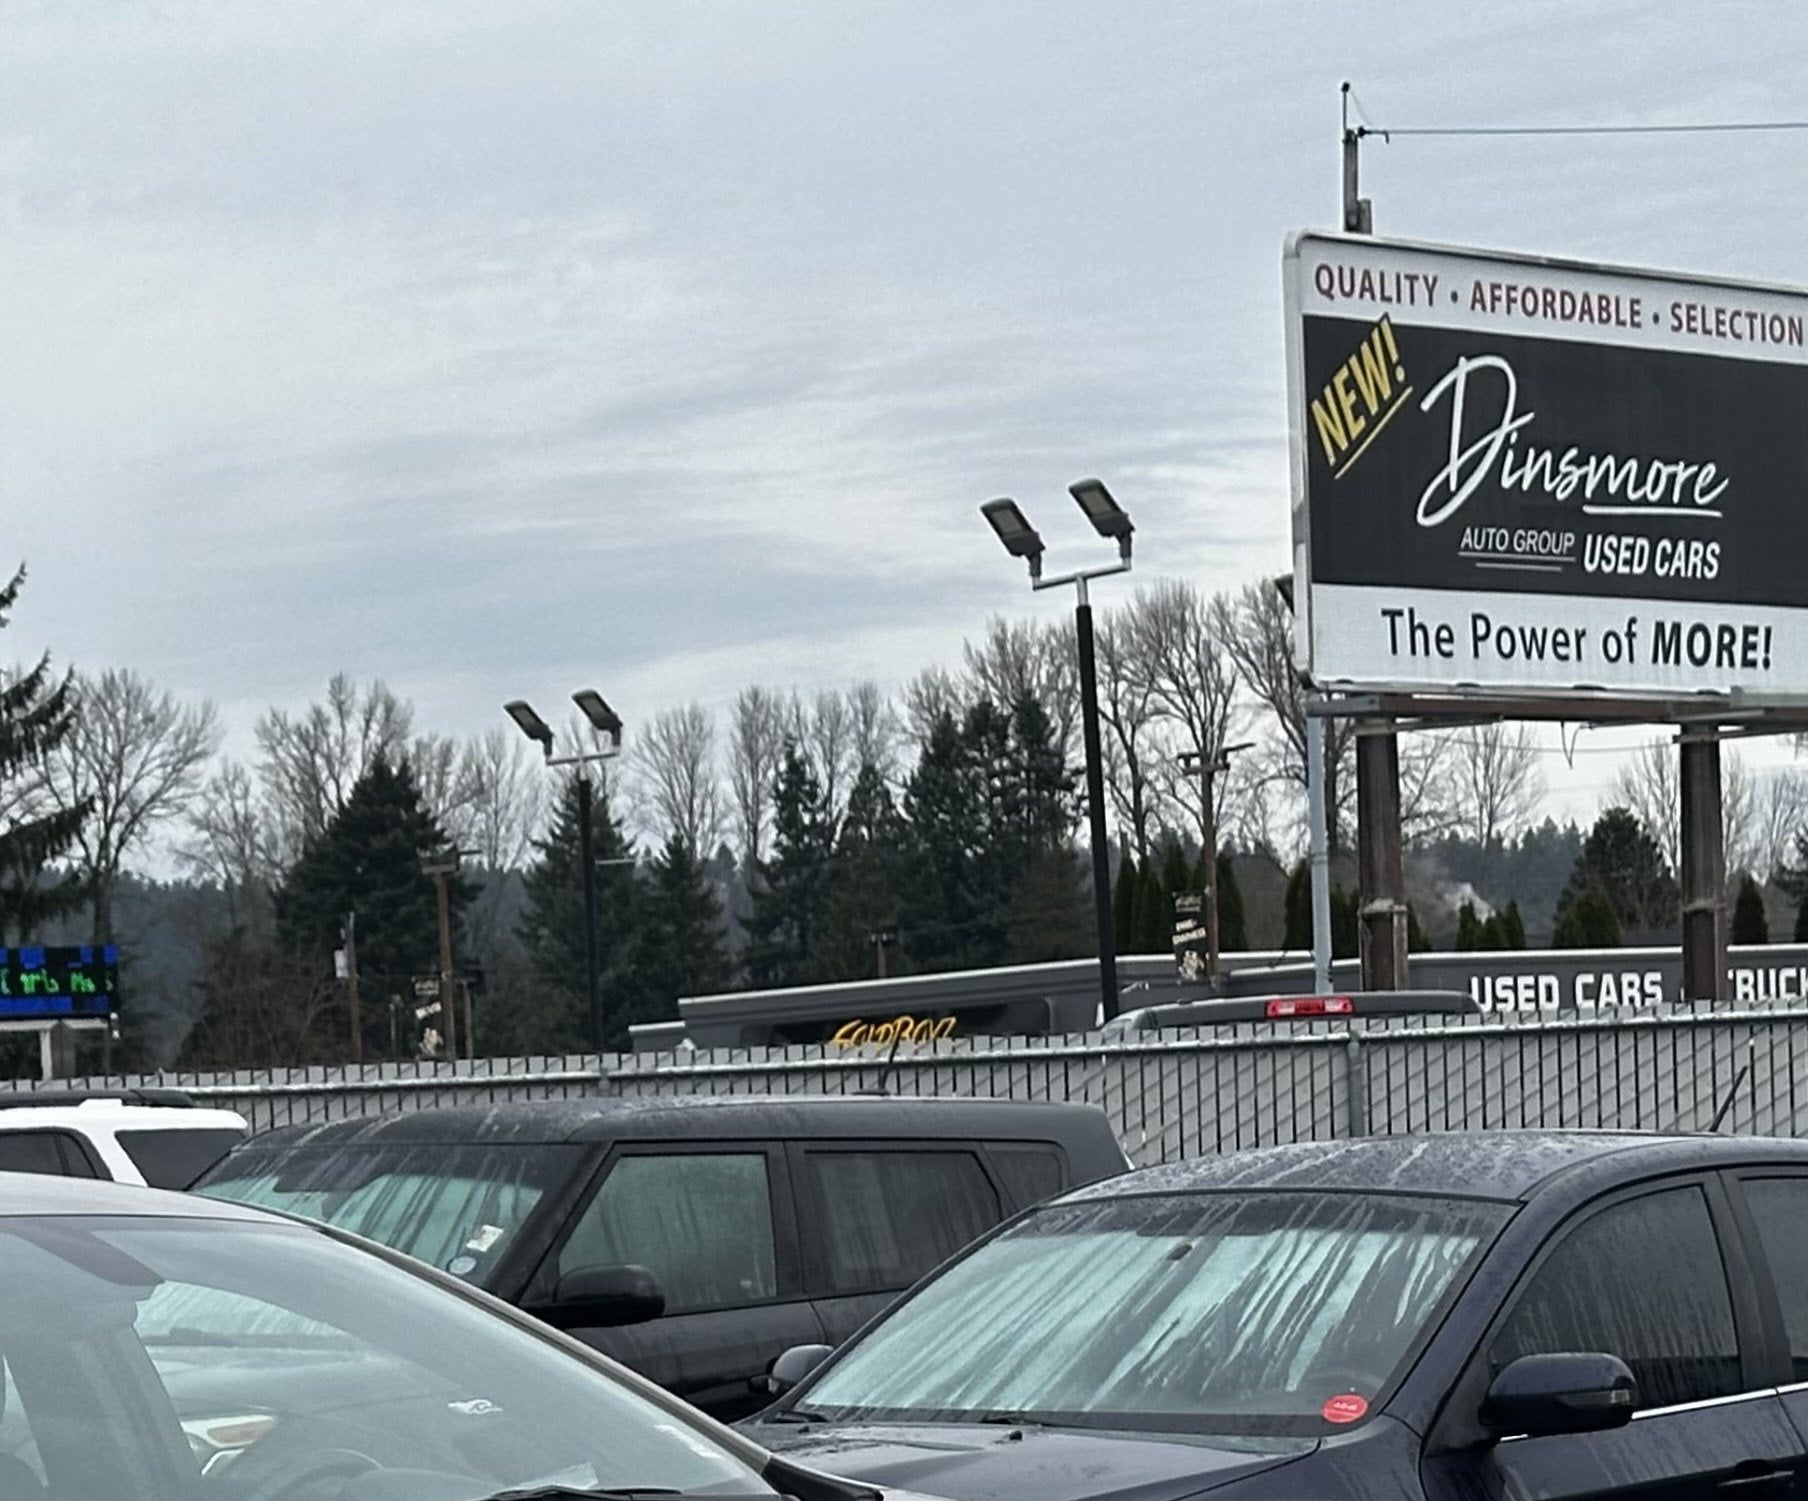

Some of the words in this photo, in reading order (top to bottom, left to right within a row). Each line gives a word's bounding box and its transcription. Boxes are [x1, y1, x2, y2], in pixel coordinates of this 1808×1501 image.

[1314, 263, 1439, 307] QUALITY
[1470, 280, 1643, 329] AFFORDABLE
[1669, 302, 1804, 346] SELECTION
[1311, 316, 1406, 466] NEW!
[1416, 356, 1729, 526] Dinsmore
[1460, 527, 1509, 552] AUTO
[1513, 530, 1575, 555] GROUP
[1583, 534, 1648, 576] USED
[1654, 541, 1720, 580] CARS
[1381, 608, 1455, 658] The
[1470, 613, 1586, 663] Power
[1602, 618, 1638, 664] of
[1651, 621, 1773, 670] MORE!
[1471, 974, 1560, 1012] USED
[1576, 971, 1664, 1011] CARS
